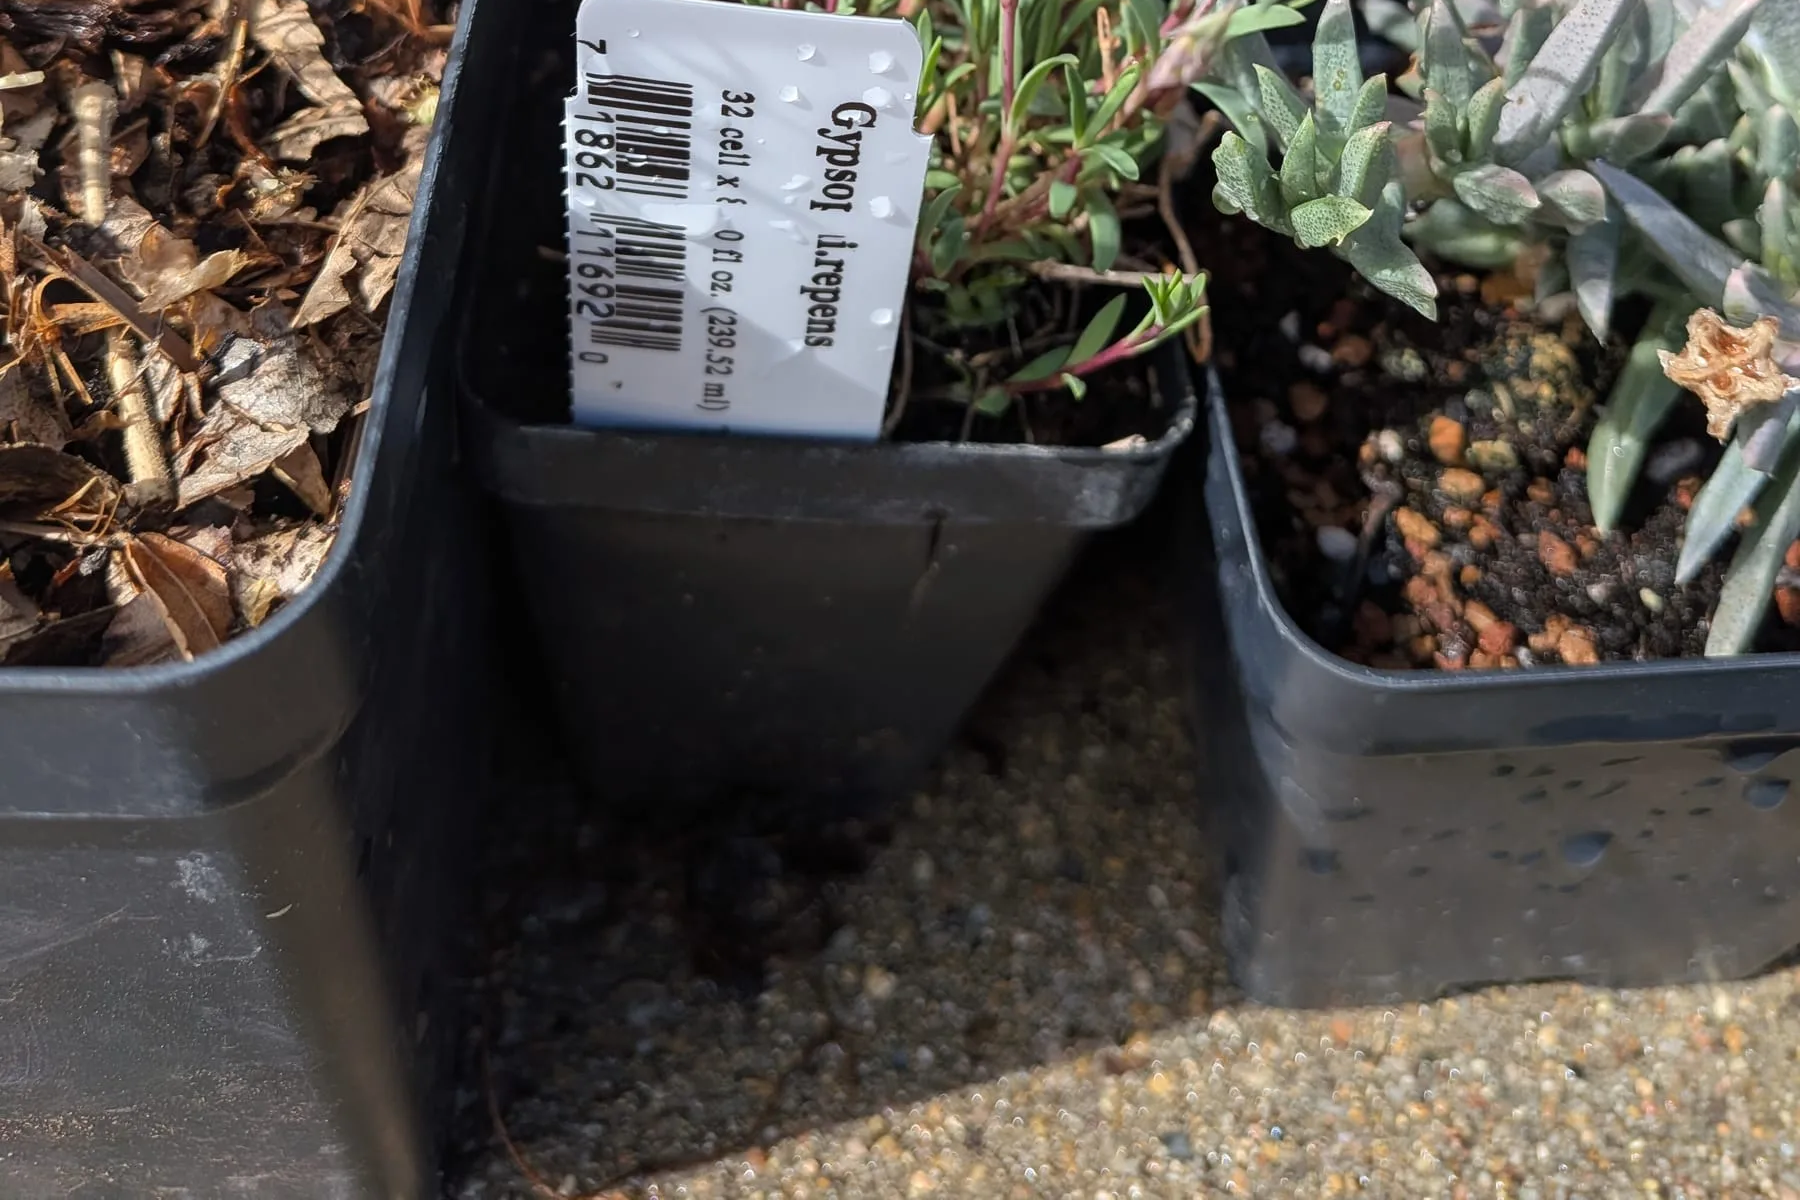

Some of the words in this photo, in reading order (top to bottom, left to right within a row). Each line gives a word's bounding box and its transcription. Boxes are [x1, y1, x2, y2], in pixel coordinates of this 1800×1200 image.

[577, 39, 607, 55] 7
[720, 89, 755, 118] 32
[718, 127, 752, 167] cell
[716, 174, 740, 188] x
[712, 248, 743, 263] fl
[576, 229, 615, 319] 11692
[710, 270, 734, 297] oz.
[700, 307, 738, 376] (239.52
[578, 351, 609, 364] 0
[696, 382, 731, 411] ml)
